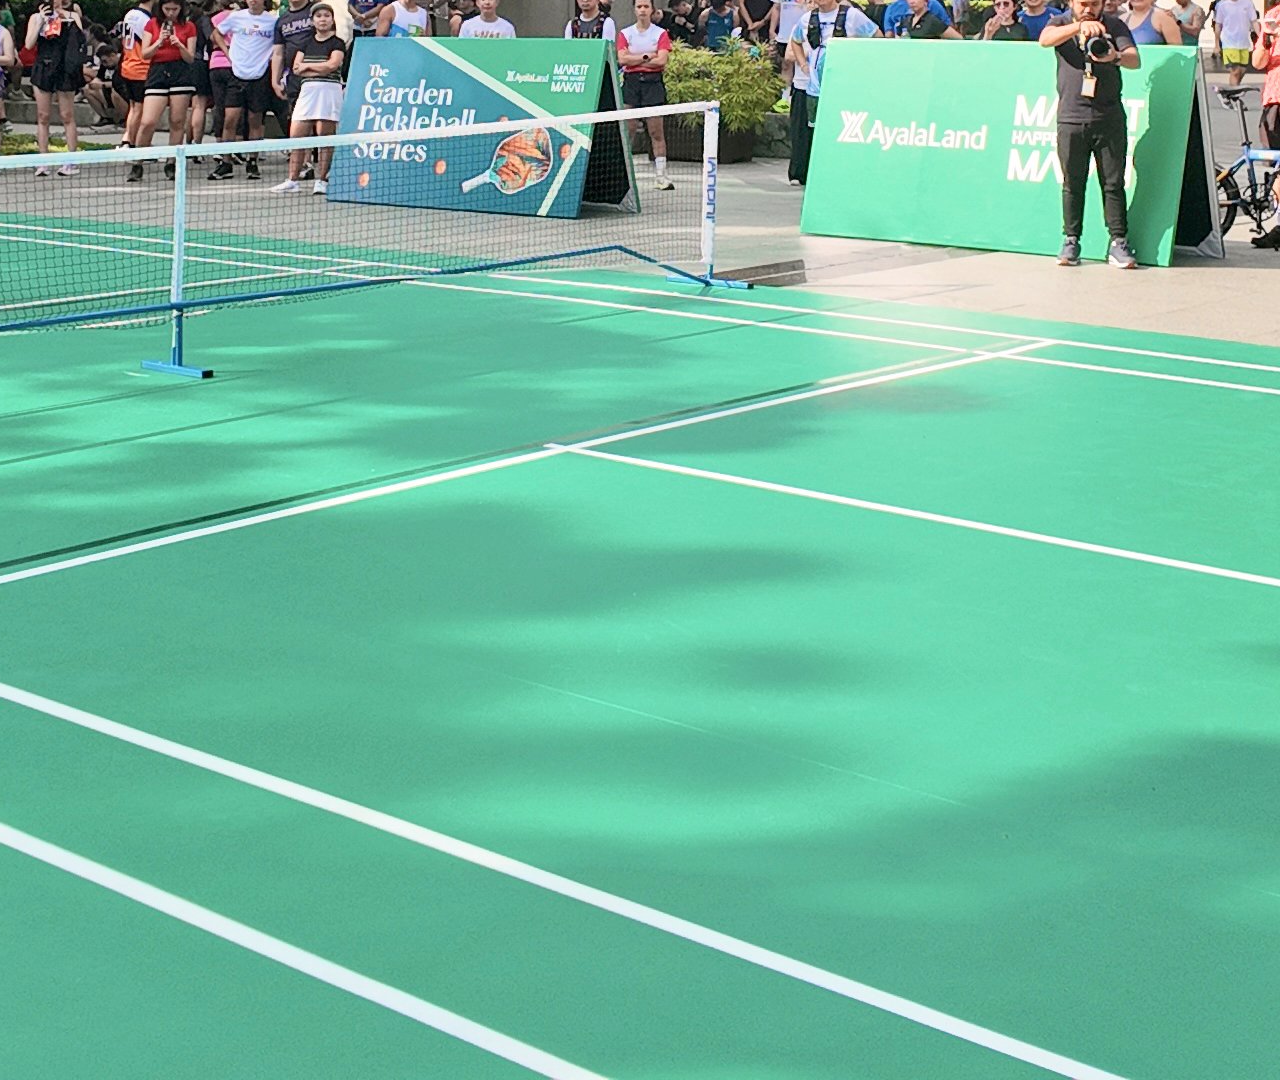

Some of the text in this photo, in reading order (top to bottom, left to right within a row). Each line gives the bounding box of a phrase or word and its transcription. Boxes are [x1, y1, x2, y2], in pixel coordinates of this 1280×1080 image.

[369, 63, 390, 77] The
[364, 77, 453, 107] Garden
[550, 81, 586, 93] MAKATI
[866, 119, 988, 151] AyalaLand
[353, 141, 428, 163] Series
